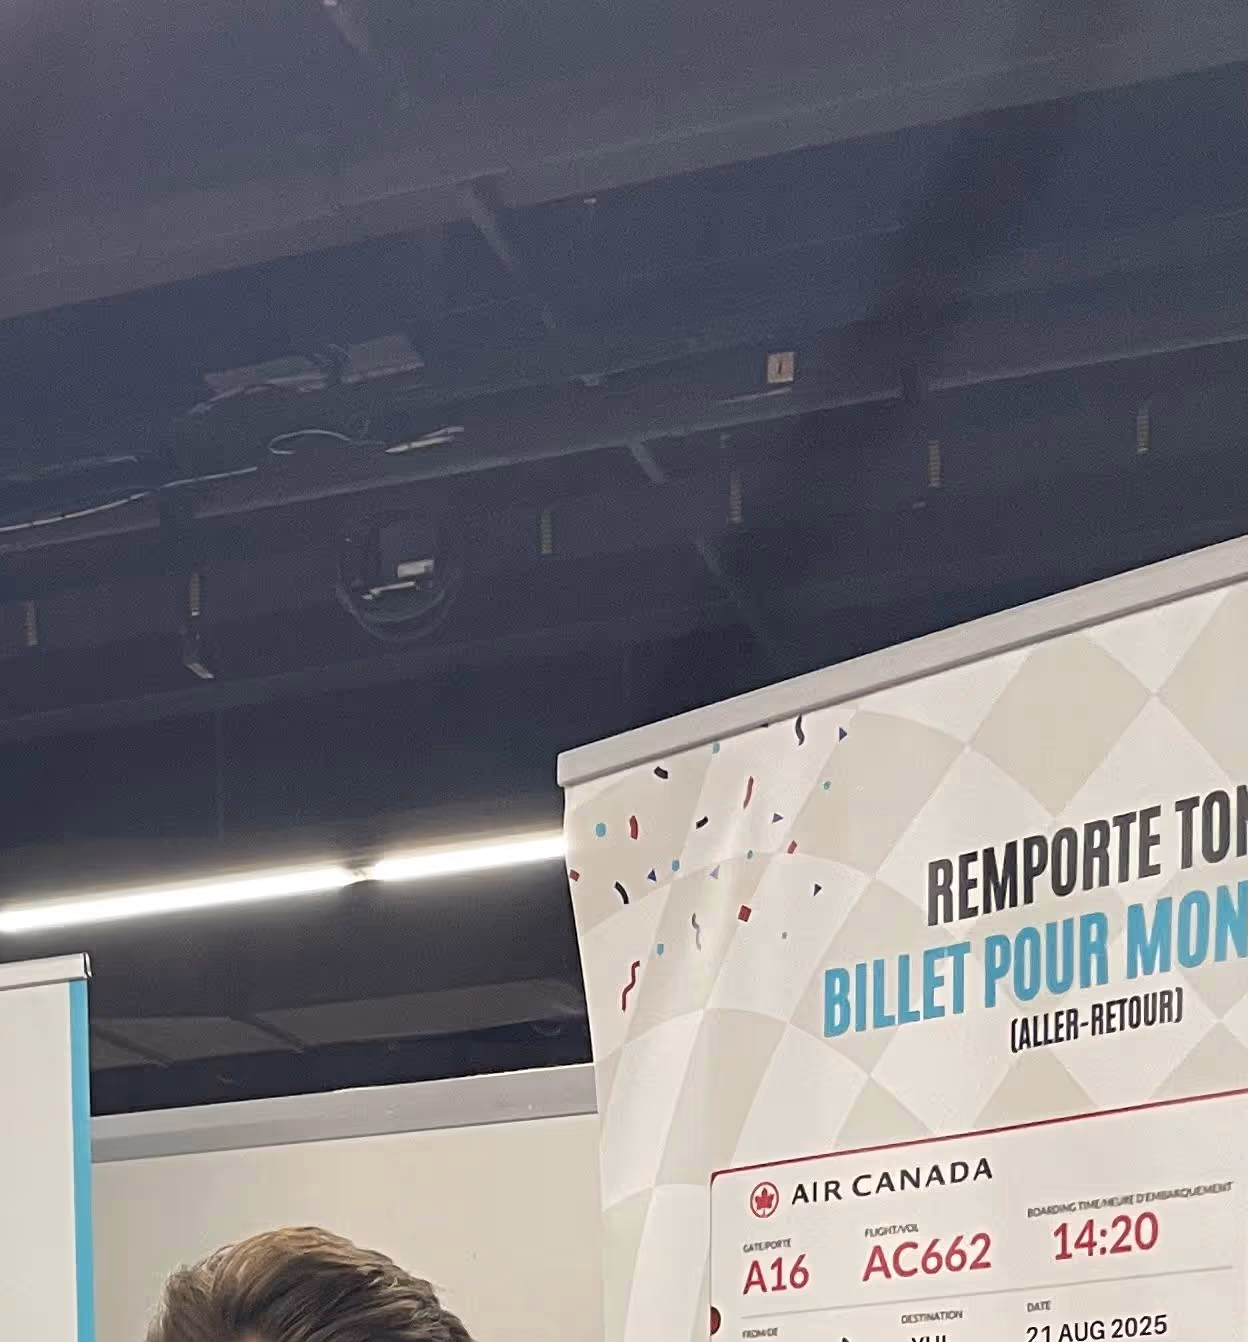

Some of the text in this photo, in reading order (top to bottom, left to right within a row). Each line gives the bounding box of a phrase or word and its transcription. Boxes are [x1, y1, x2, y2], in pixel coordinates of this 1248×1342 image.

[927, 805, 1160, 926] REMPORTE
[823, 941, 971, 1038] BILLET
[985, 912, 1108, 1009] POUR
[1010, 988, 1183, 1053] (ALLER-RETOUR)
[792, 1157, 992, 1205] AIR CANADA
[1027, 1202, 1076, 1218] BOARDING
[862, 1232, 992, 1282] AC662
[1054, 1211, 1159, 1260] 14:20
[743, 1253, 809, 1295] A16
[901, 1310, 963, 1324] DESTINATION
[1027, 1300, 1051, 1312] DATE
[1058, 1321, 1105, 1342] AUG
[1111, 1314, 1168, 1340] 2025
